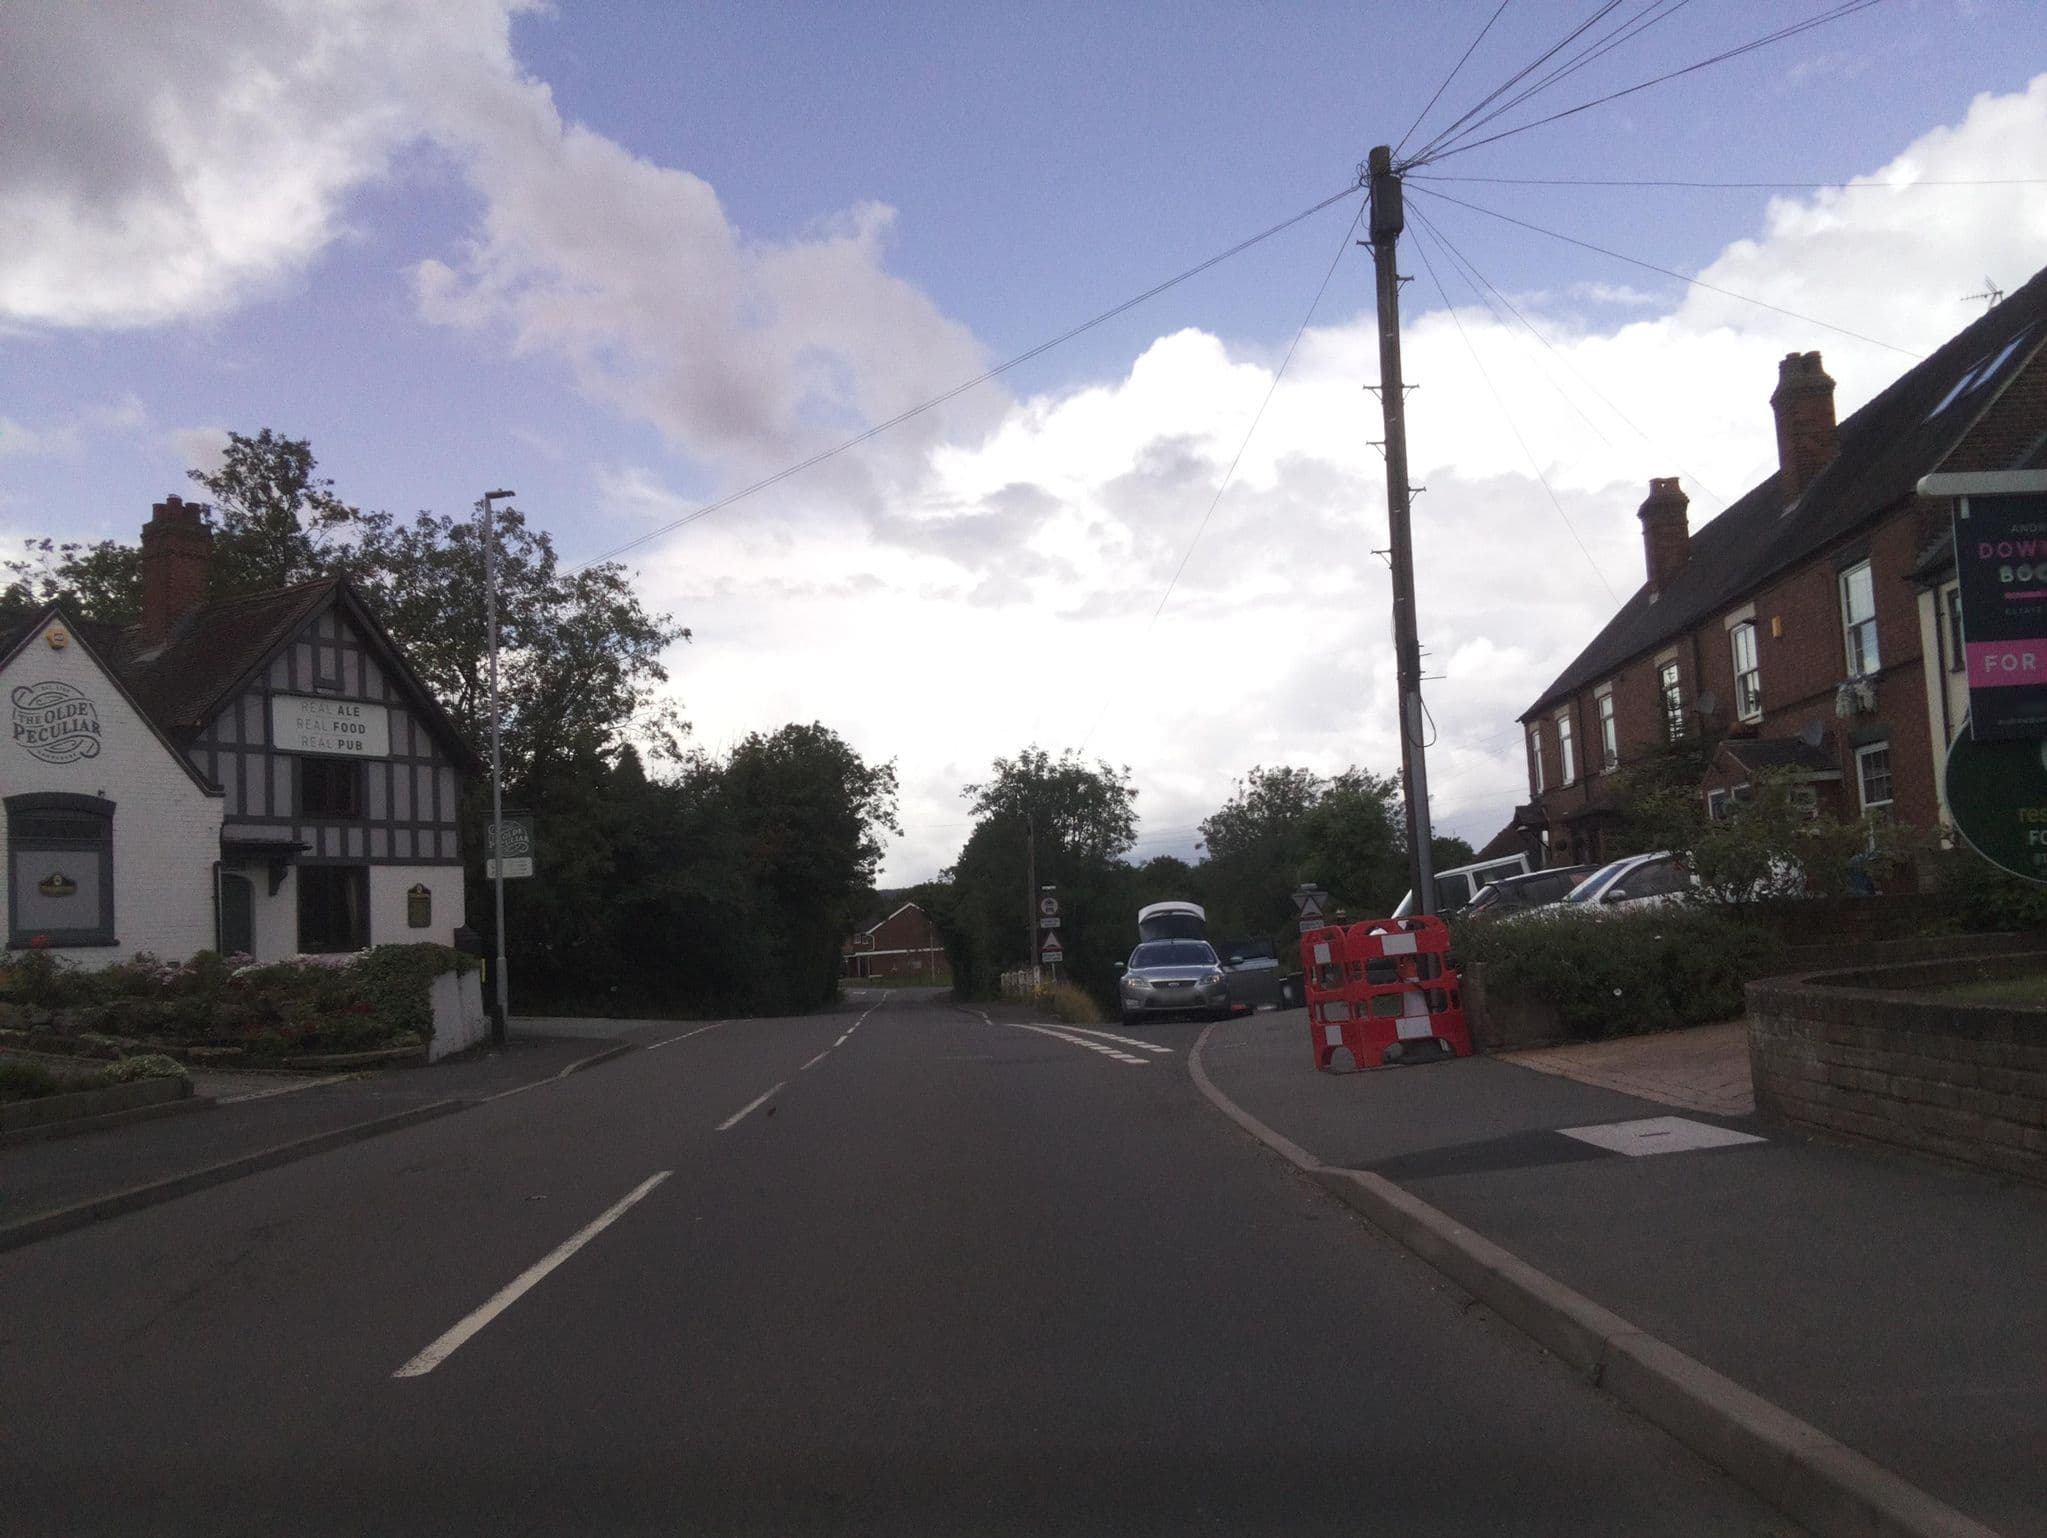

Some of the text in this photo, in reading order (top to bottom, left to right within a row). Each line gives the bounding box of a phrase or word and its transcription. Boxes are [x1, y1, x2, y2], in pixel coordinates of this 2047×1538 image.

[1984, 652, 2037, 672] FOR
[18, 702, 88, 725] THE OLDE
[301, 701, 360, 717] REAL ALE
[13, 718, 102, 743] PECULIAR
[296, 718, 366, 734] REAL FOOD
[301, 736, 363, 751] REAL PUB
